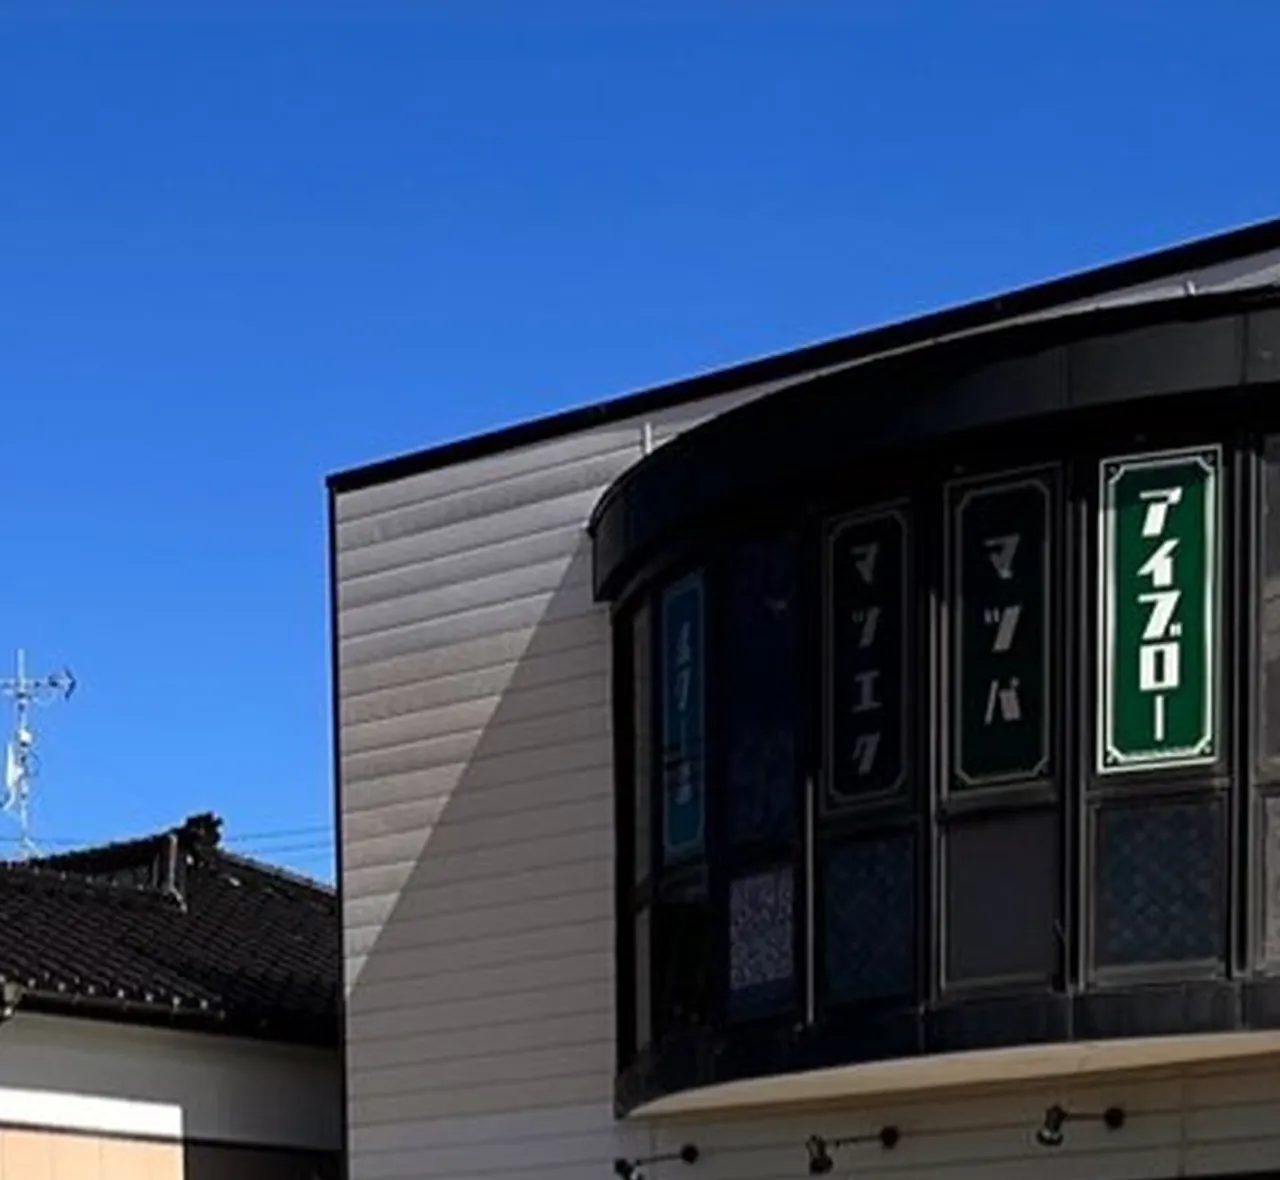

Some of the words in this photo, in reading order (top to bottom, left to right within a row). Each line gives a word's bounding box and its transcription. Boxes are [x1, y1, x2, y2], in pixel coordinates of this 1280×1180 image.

[1136, 486, 1182, 741] アイブロー
